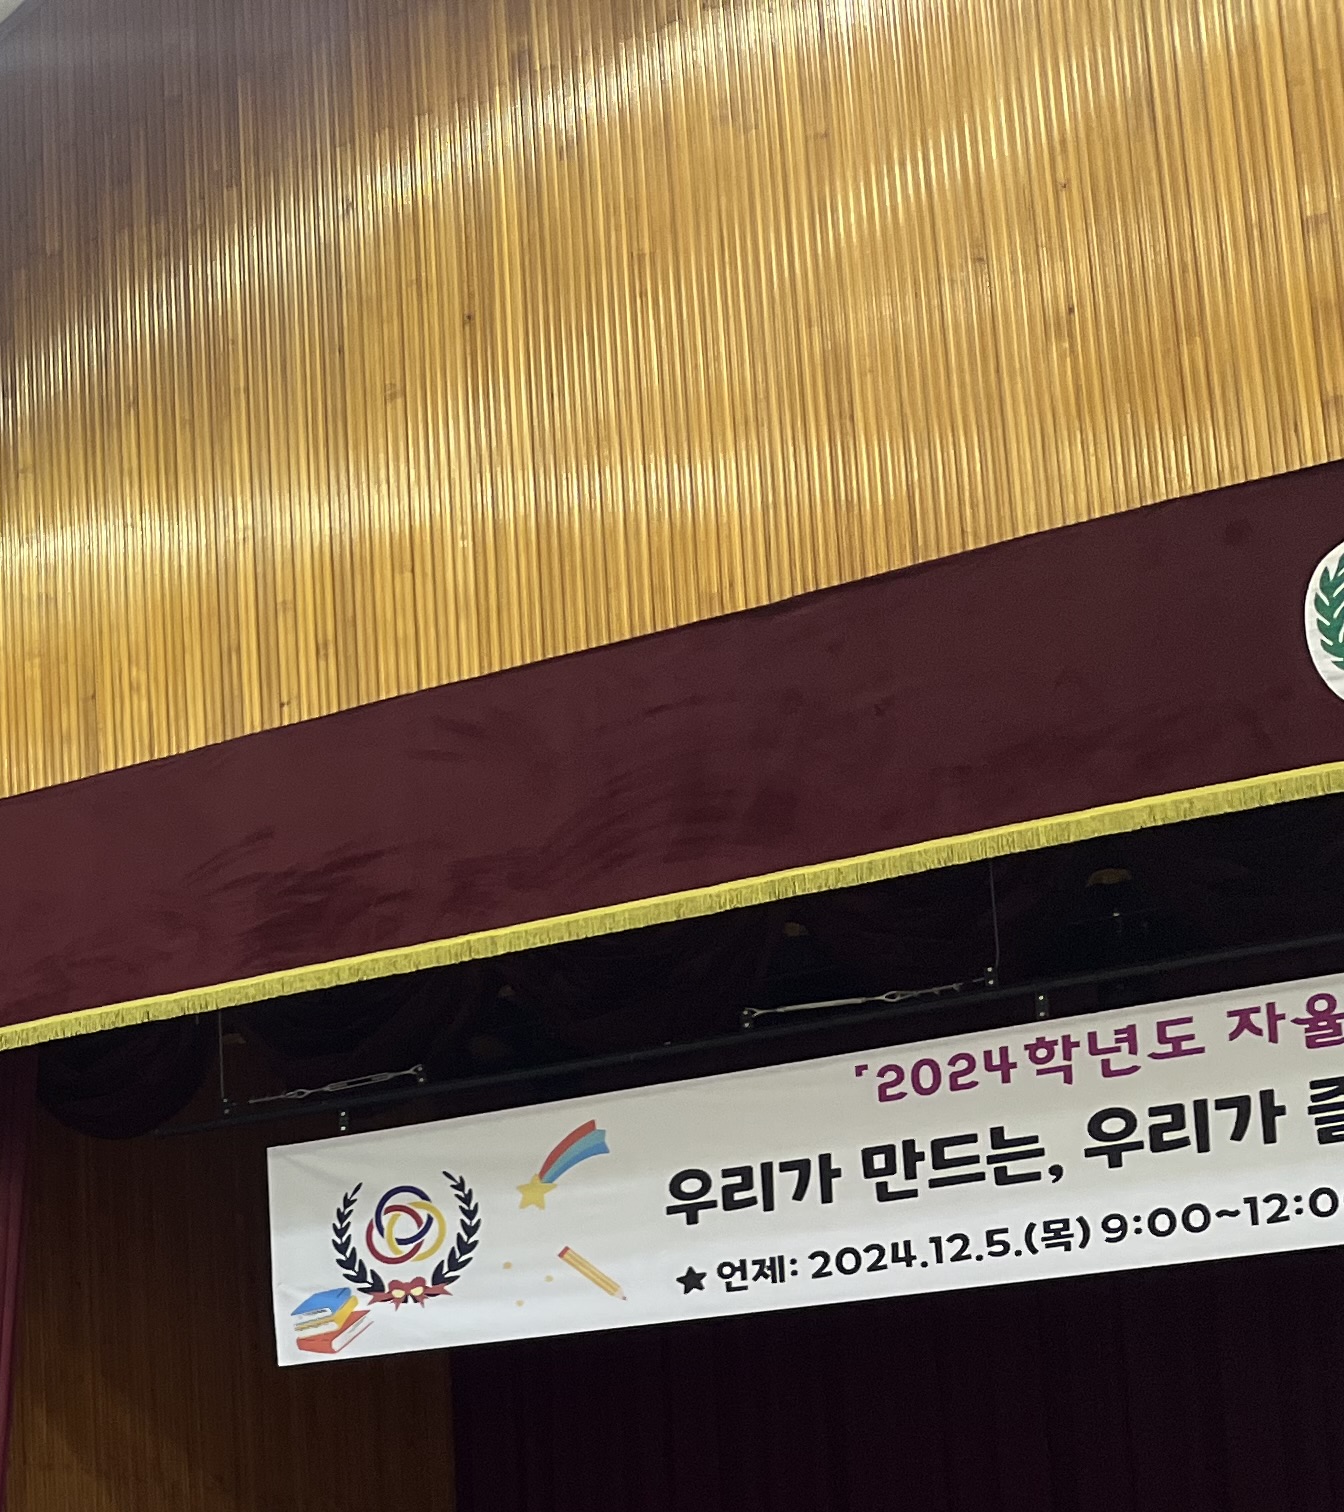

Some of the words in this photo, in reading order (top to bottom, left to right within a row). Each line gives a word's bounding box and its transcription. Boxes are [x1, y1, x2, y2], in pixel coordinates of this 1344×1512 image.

[665, 1152, 842, 1226] 우리가
[861, 1125, 1064, 1203] 만드는,
[1083, 1088, 1287, 1169] 우리가
[716, 1254, 799, 1293] 언제:
[1101, 1187, 1344, 1243] 9:00~12:0
